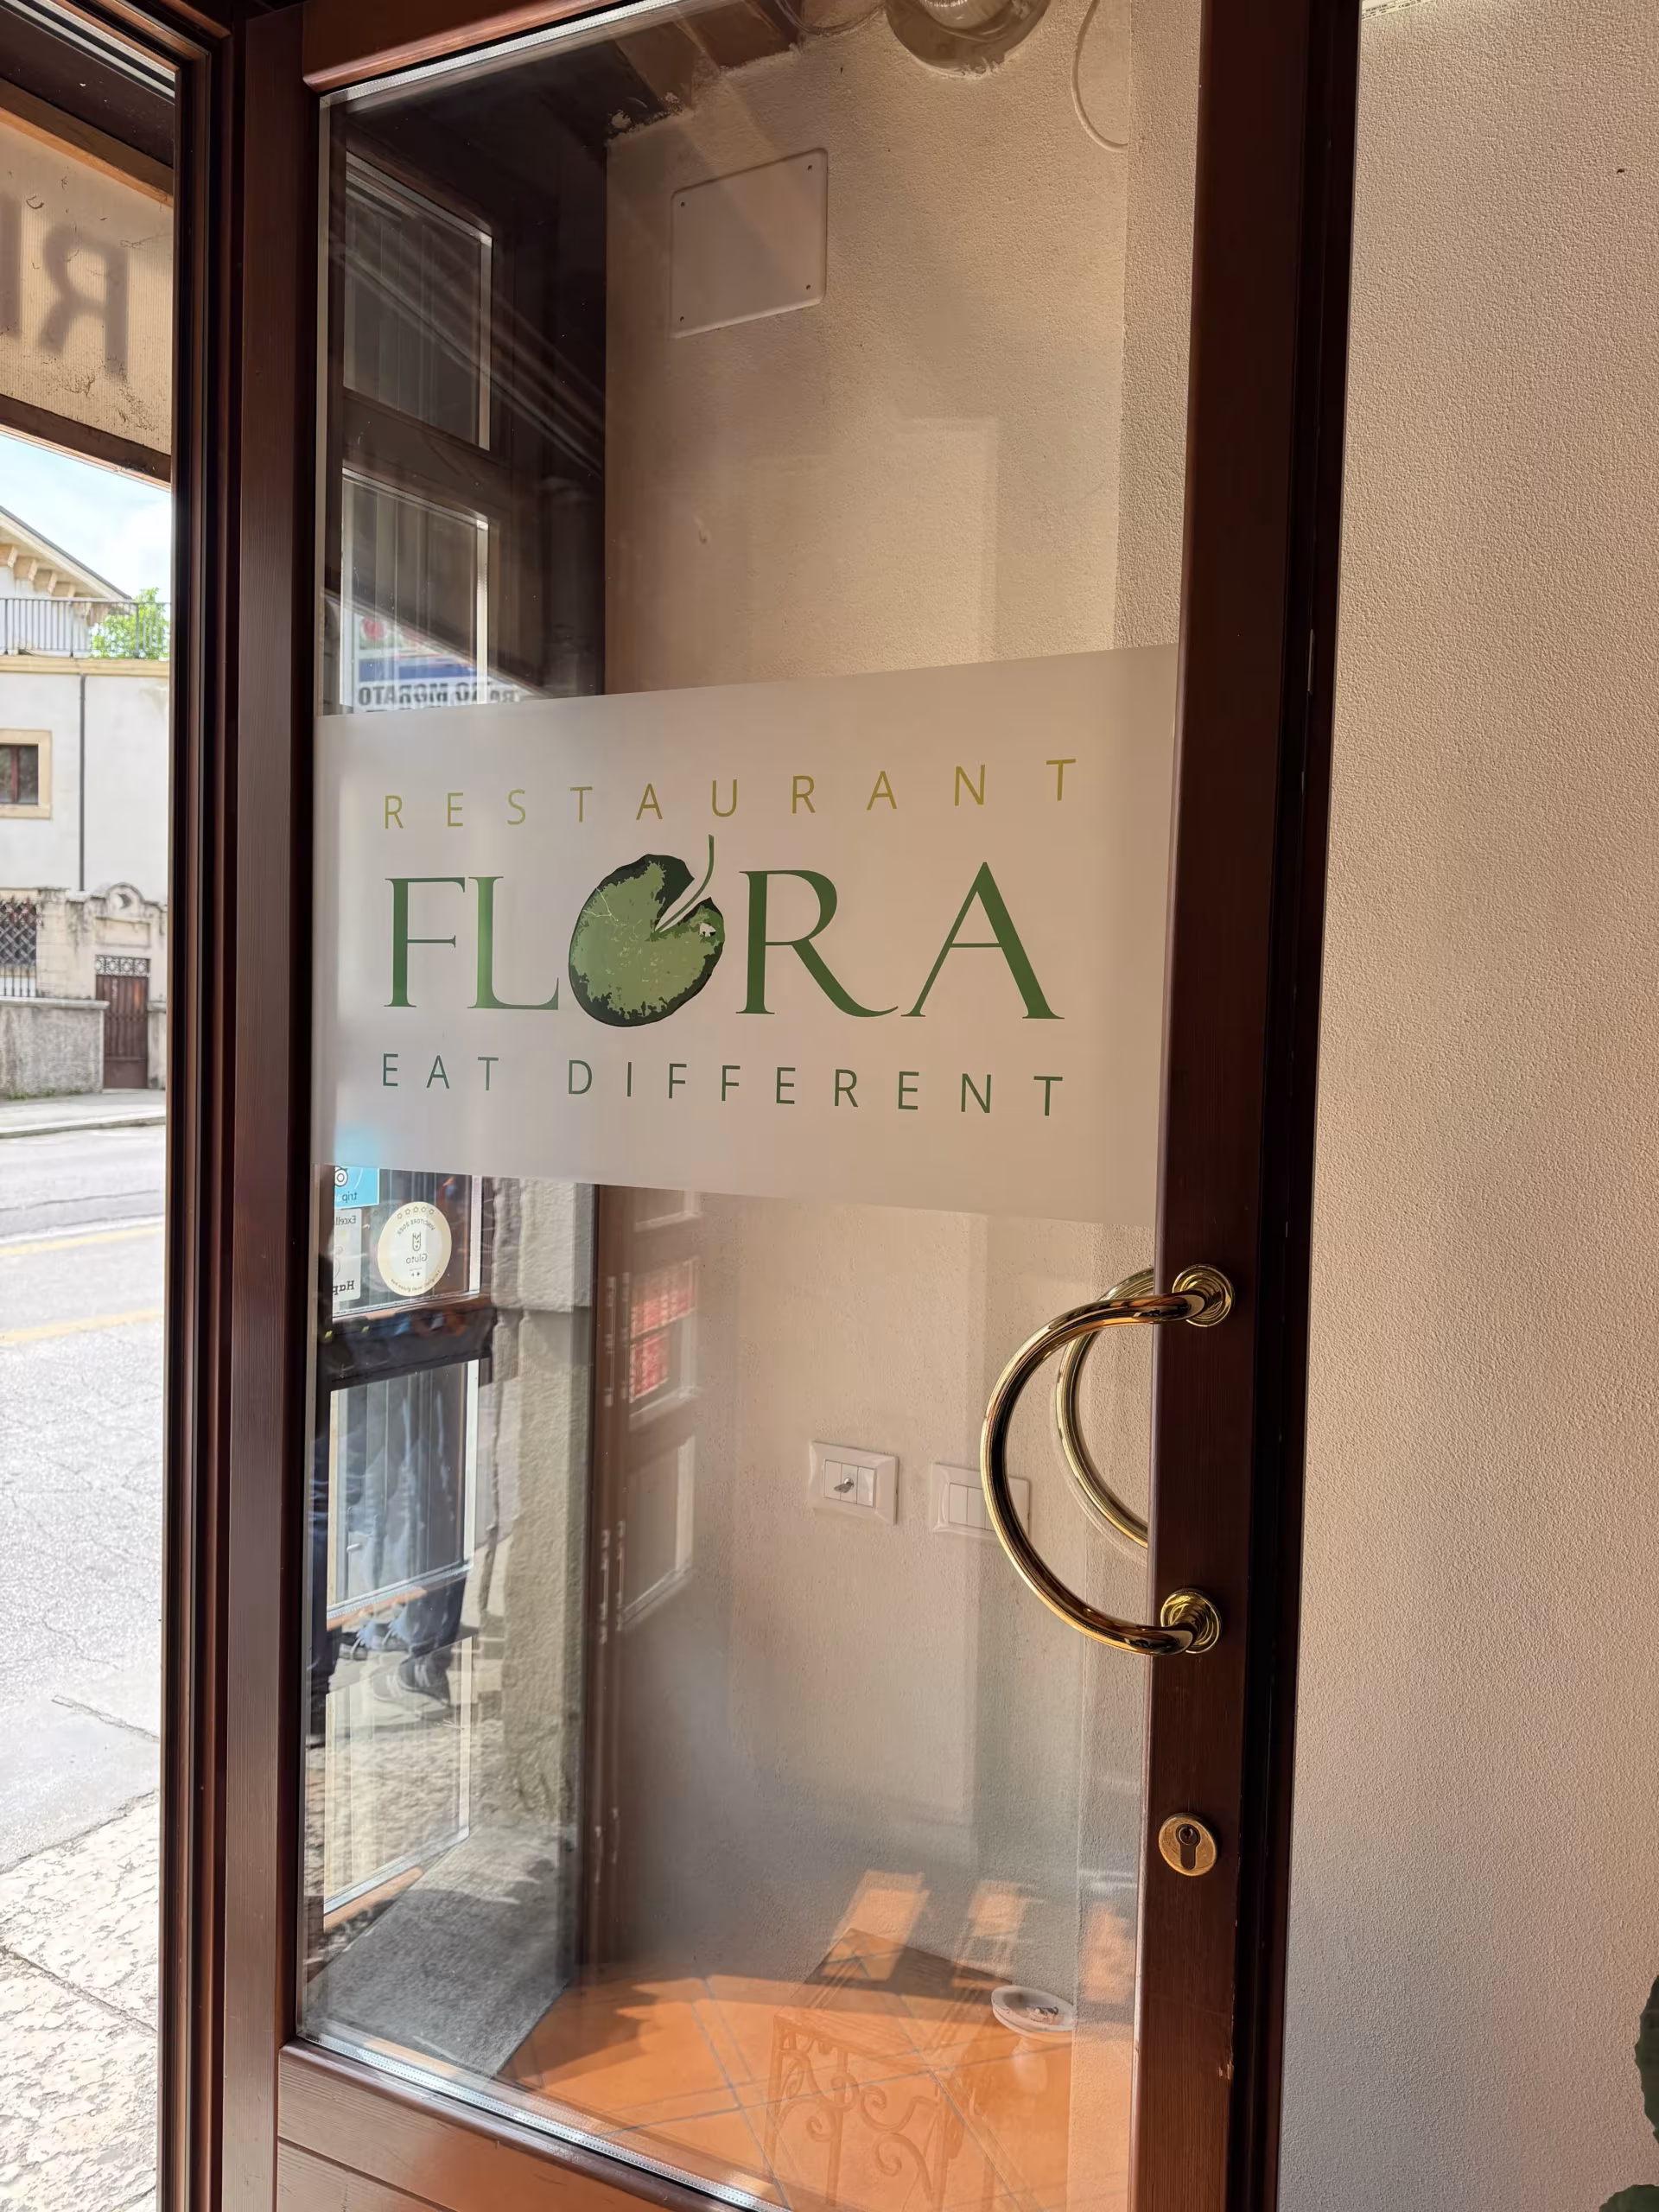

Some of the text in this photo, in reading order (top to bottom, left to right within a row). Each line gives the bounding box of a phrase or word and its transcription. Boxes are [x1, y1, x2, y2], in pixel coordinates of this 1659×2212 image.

[385, 759, 1077, 830] RESTAURANT
[384, 851, 1065, 1027] FLORA
[383, 1053, 1064, 1117] EAT DIFFERENT
